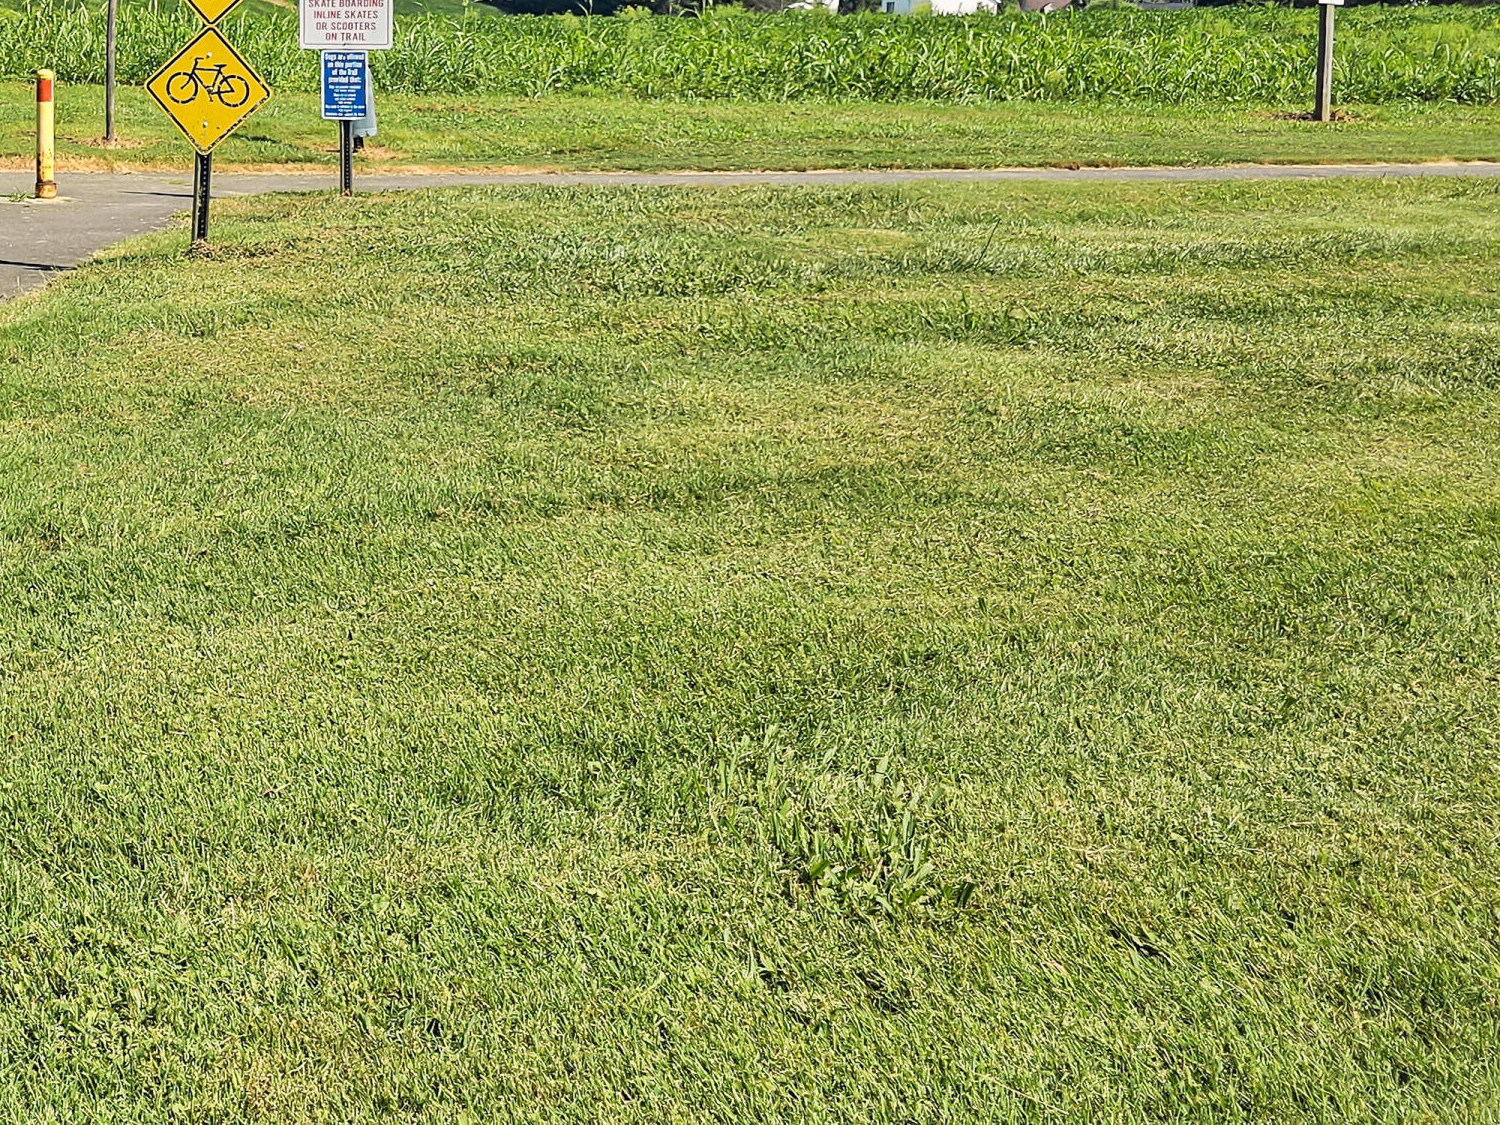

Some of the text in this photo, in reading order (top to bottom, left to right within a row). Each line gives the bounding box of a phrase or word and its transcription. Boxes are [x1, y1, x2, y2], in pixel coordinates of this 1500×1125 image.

[308, 0, 384, 8] SKATE BOARDING
[313, 10, 379, 19] INLINE SKATES
[316, 22, 376, 31] OR SCOOTERS
[325, 32, 367, 41] ON TRAIL
